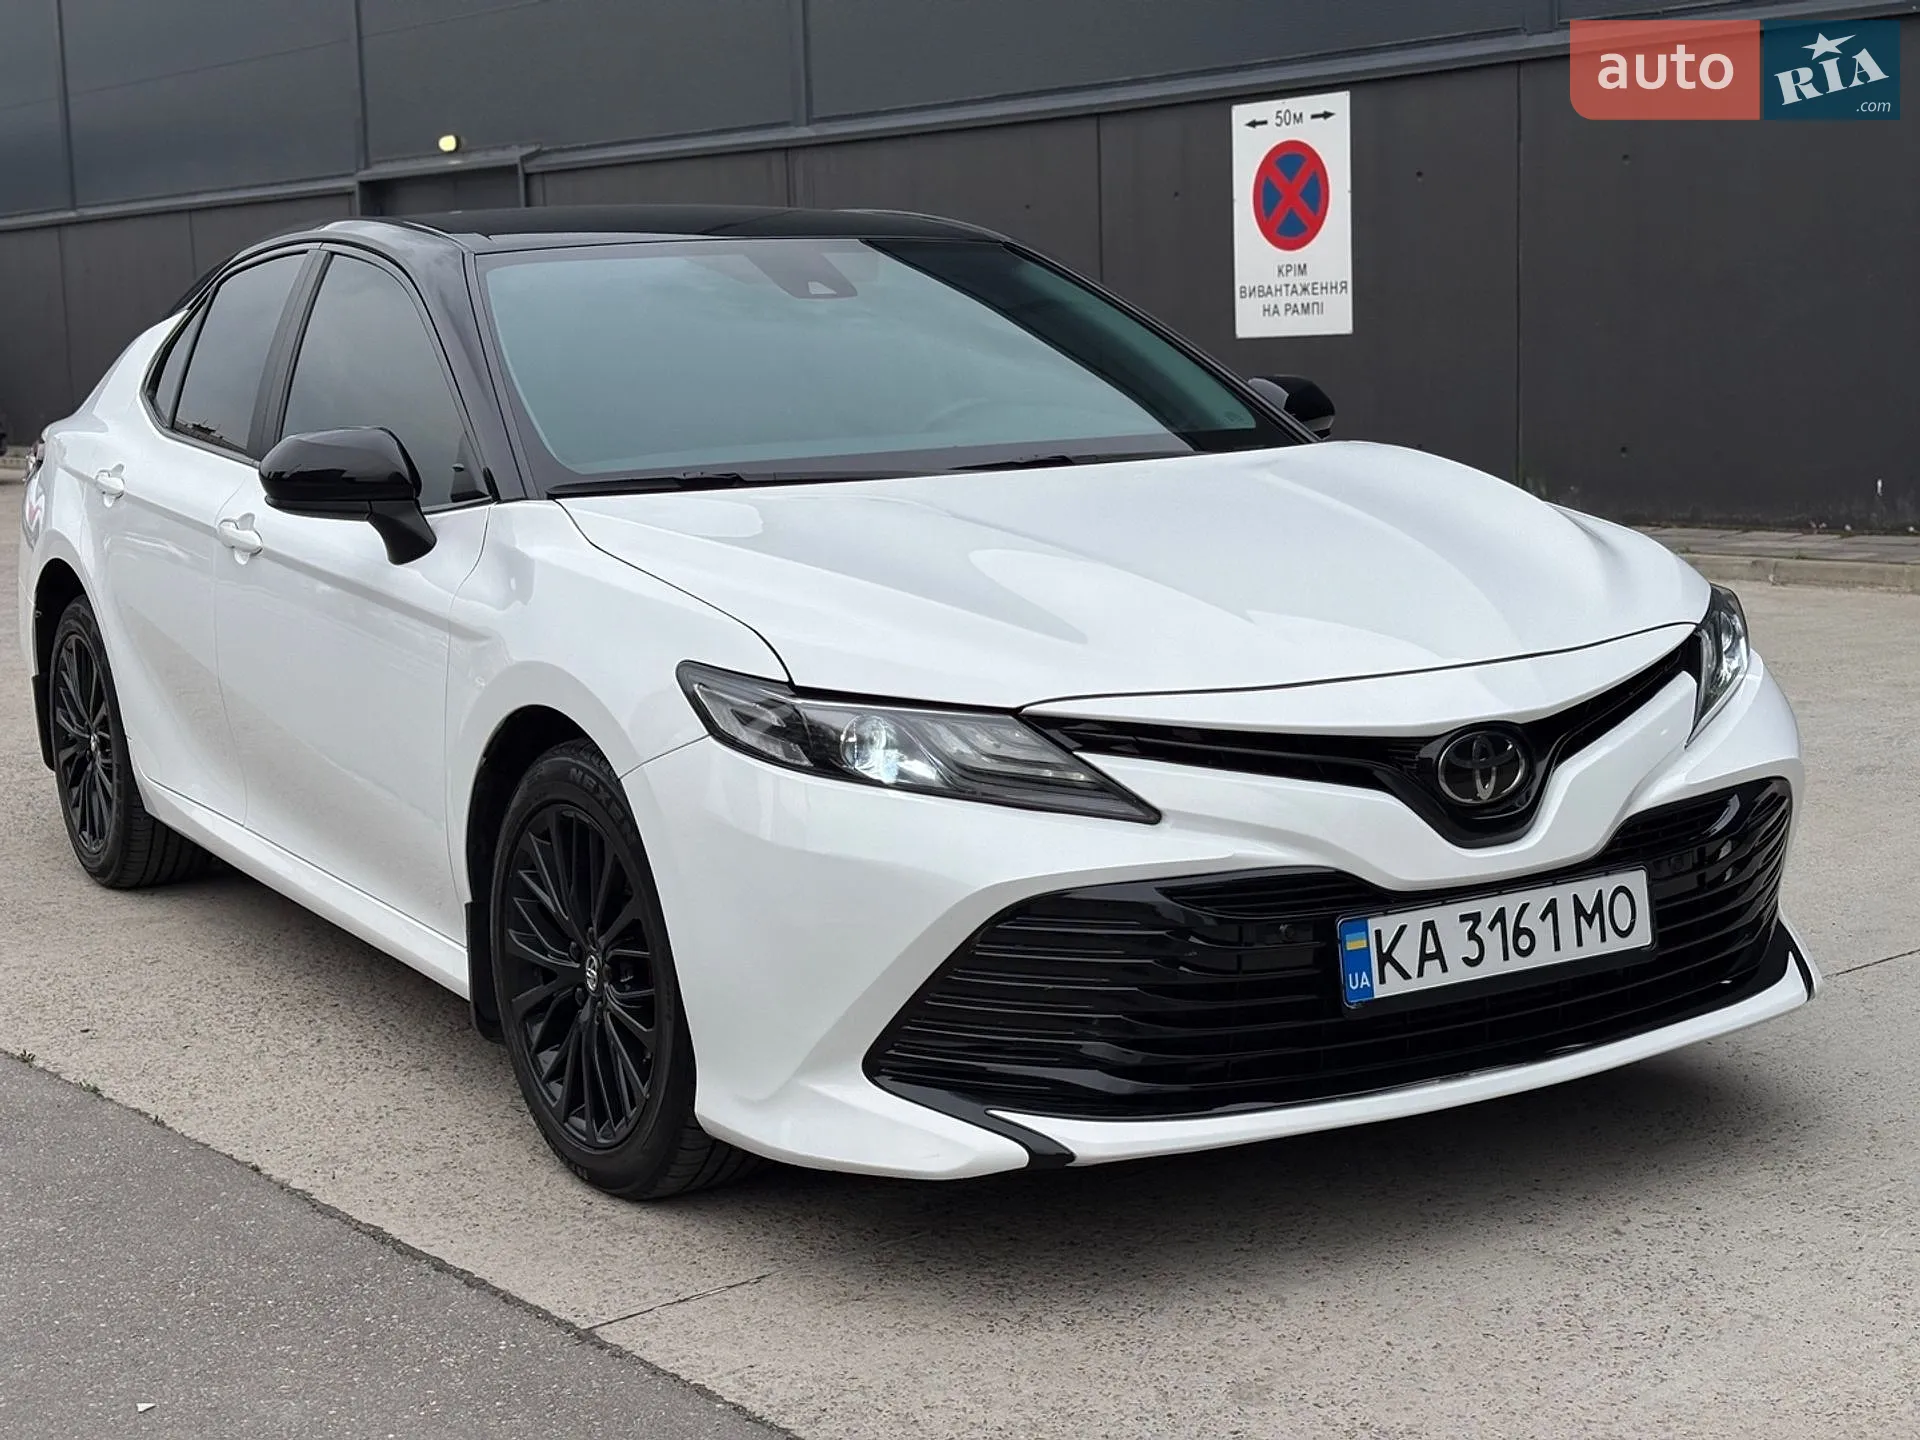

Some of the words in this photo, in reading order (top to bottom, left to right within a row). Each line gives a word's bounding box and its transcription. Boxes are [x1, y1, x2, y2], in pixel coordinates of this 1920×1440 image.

[1277, 263, 1308, 278] КРІМ
[1239, 280, 1349, 299] ВИВАНТАЖЕННЯ
[1262, 303, 1281, 317] НА
[1284, 301, 1325, 316] РАМПІ
[1374, 919, 1449, 985] KA
[1458, 897, 1561, 968] 3161
[1571, 885, 1637, 948] MO
[1349, 970, 1371, 991] UA
